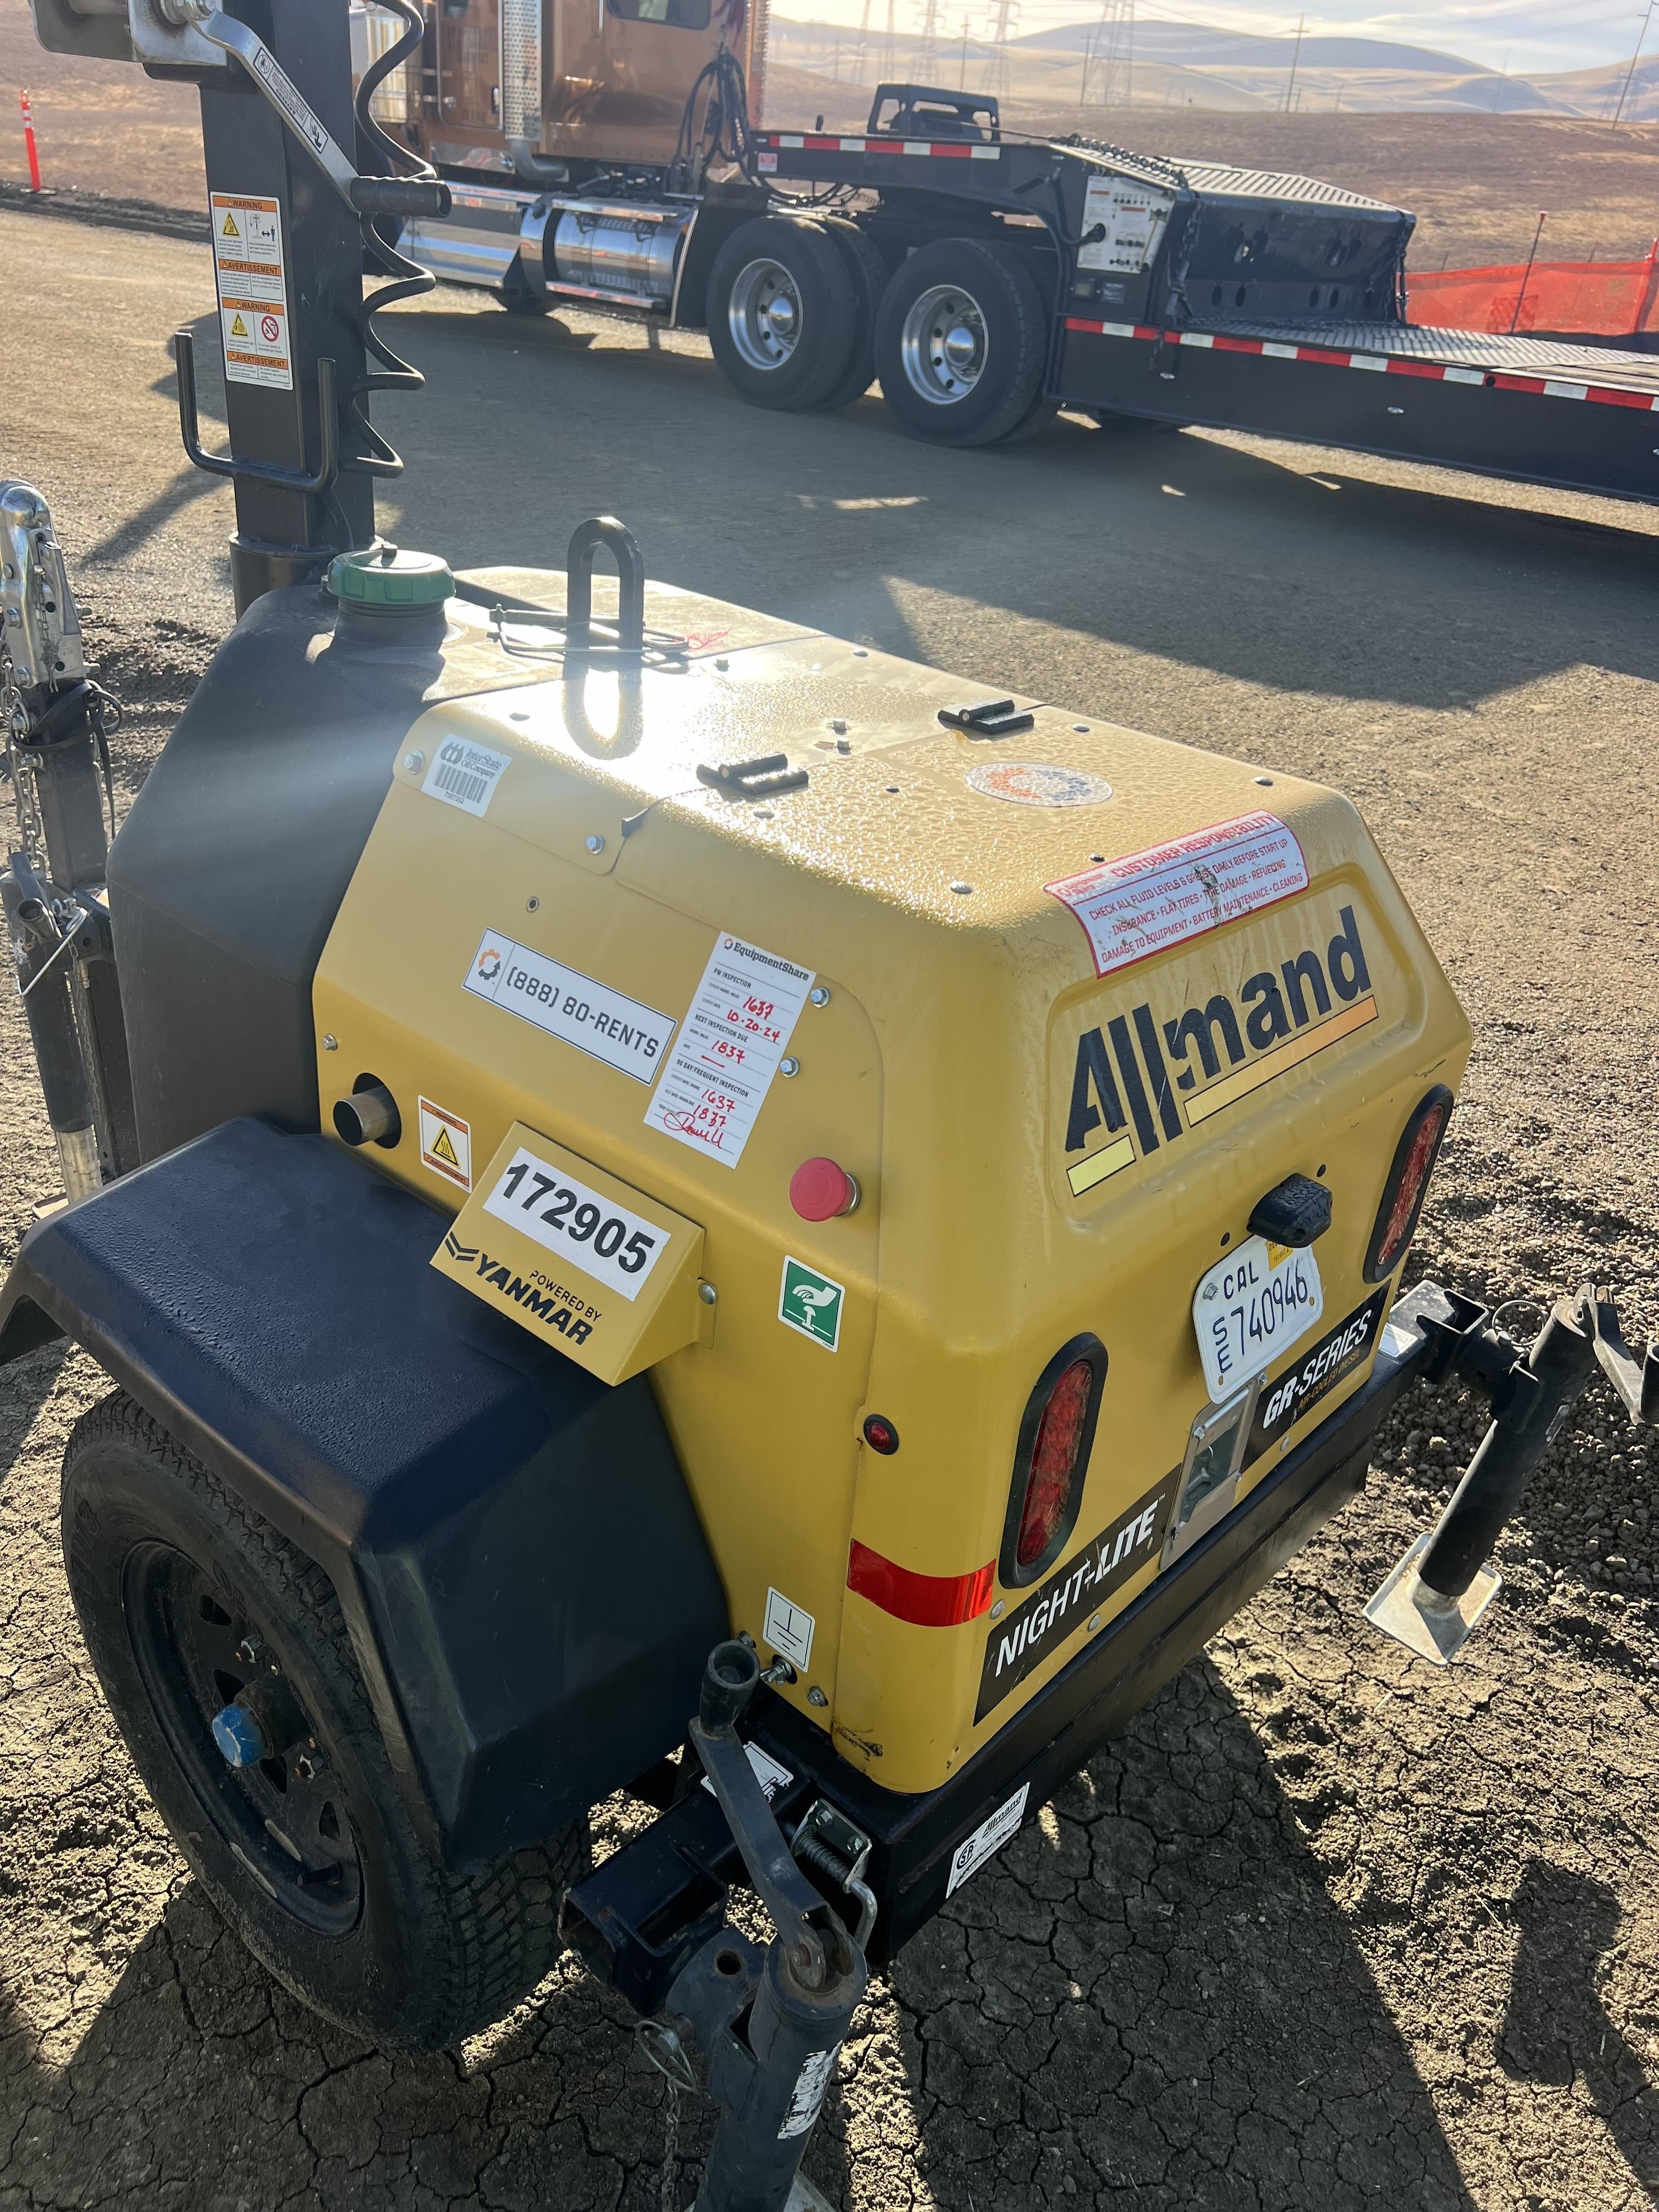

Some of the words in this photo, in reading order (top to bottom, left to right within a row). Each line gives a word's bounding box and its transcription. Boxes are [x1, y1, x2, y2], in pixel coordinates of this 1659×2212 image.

[233, 200, 262, 209] WARNING
[228, 261, 278, 274] AVERTISSEMENT
[241, 302, 270, 312] WARNING
[236, 354, 285, 368] AVERTISSEMENT
[461, 759, 470, 768] Oil
[470, 761, 496, 779] Company
[1110, 847, 1184, 878] CUSTOMER
[1178, 814, 1277, 853] RESPONSIBILITY
[1089, 902, 1118, 920] CHECK
[1116, 898, 1131, 911] ALL
[1130, 889, 1155, 905] FLUID
[1153, 879, 1181, 896] LEVELS
[1180, 877, 1187, 885] &
[1186, 867, 1212, 883] GREASE
[1212, 859, 1234, 874] DAILY
[1233, 849, 1260, 866] BEFORE
[1260, 840, 1280, 856] START
[1279, 838, 1288, 848] UP
[1111, 910, 1156, 935] INSURANCE
[1160, 901, 1177, 916] FLAT
[1177, 893, 1199, 910] TIRES
[1220, 874, 1248, 893] DAMAGE
[1251, 859, 1286, 880] REFUELING
[1102, 941, 1135, 963] DAMAGE
[1135, 937, 1145, 949] TO
[1147, 919, 1188, 945] EQUIPMENT
[1193, 906, 1222, 925] BATTERY
[1223, 886, 1269, 913] MAINTENANCE
[1273, 872, 1303, 892] CLEANING
[722, 972, 751, 988] INSPECTION
[733, 942, 809, 981] EquipmentShare
[507, 966, 560, 1008] (888)
[562, 996, 659, 1058] 80-RENTS
[743, 996, 774, 1020] 1637
[695, 1014, 707, 1024] NEXT
[708, 1020, 738, 1037] INSPECTION
[737, 1033, 748, 1042] DUE
[1065, 905, 1372, 1156] Allmand
[712, 1040, 745, 1064] 1837
[684, 1063, 721, 1083] DAY/FREQUENT
[719, 1079, 749, 1097] INSPECTION
[436, 1110, 457, 1126] WARNING
[693, 1104, 726, 1127] 1837
[702, 1089, 735, 1113] 1637
[431, 1159, 466, 1184] AVERTISSEMENT
[503, 1163, 656, 1273] 172905
[476, 1253, 593, 1345] YANMAR
[529, 1270, 584, 1311] POWERED
[584, 1306, 602, 1322] BY
[1224, 1261, 1259, 1300] CAL
[1231, 1259, 1308, 1356] 740946
[1263, 1310, 1372, 1429] GR-SERIES
[1297, 1367, 1338, 1412] AIR-COOLED
[1338, 1348, 1361, 1373] DIESEL
[995, 1499, 1159, 1677] NIGHT-LITE
[983, 1792, 1023, 1836] Allmand
